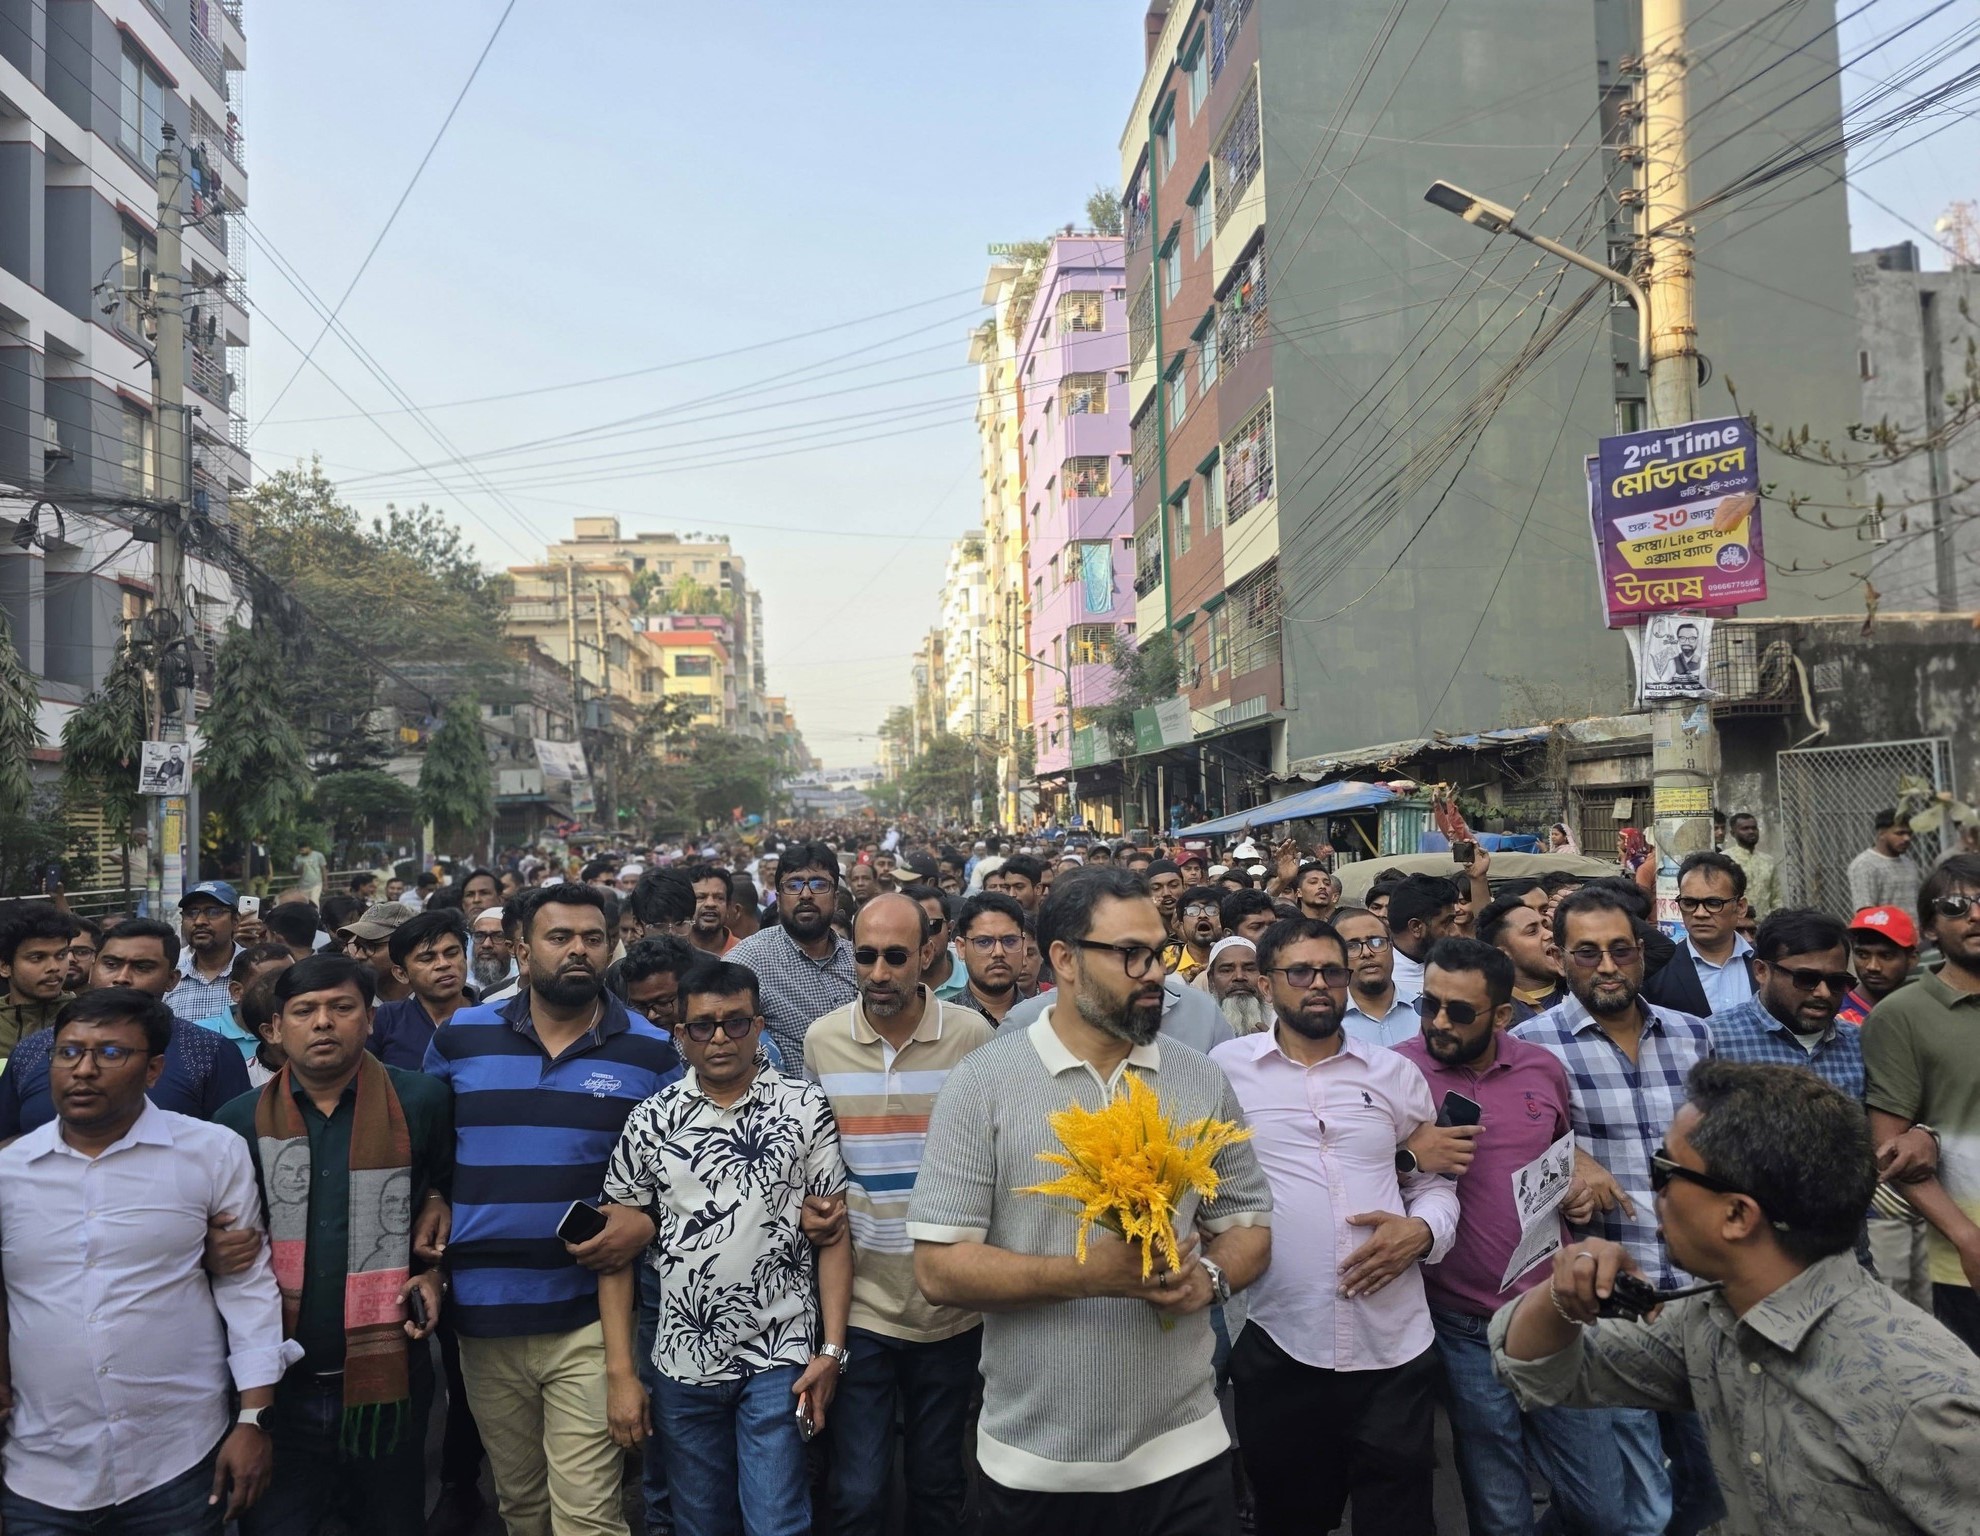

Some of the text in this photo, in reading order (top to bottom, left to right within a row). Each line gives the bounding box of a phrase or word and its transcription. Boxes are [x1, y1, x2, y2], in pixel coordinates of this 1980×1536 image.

[1623, 426, 1740, 469] 2nd Time
[1611, 446, 1747, 498] মেডিকেল
[1680, 485, 1697, 498] ভর্তি
[1653, 508, 1688, 531] ২৩
[1644, 543, 1713, 566] এক্সাম ব্যাচে
[1613, 573, 1705, 605] উন্মেষ
